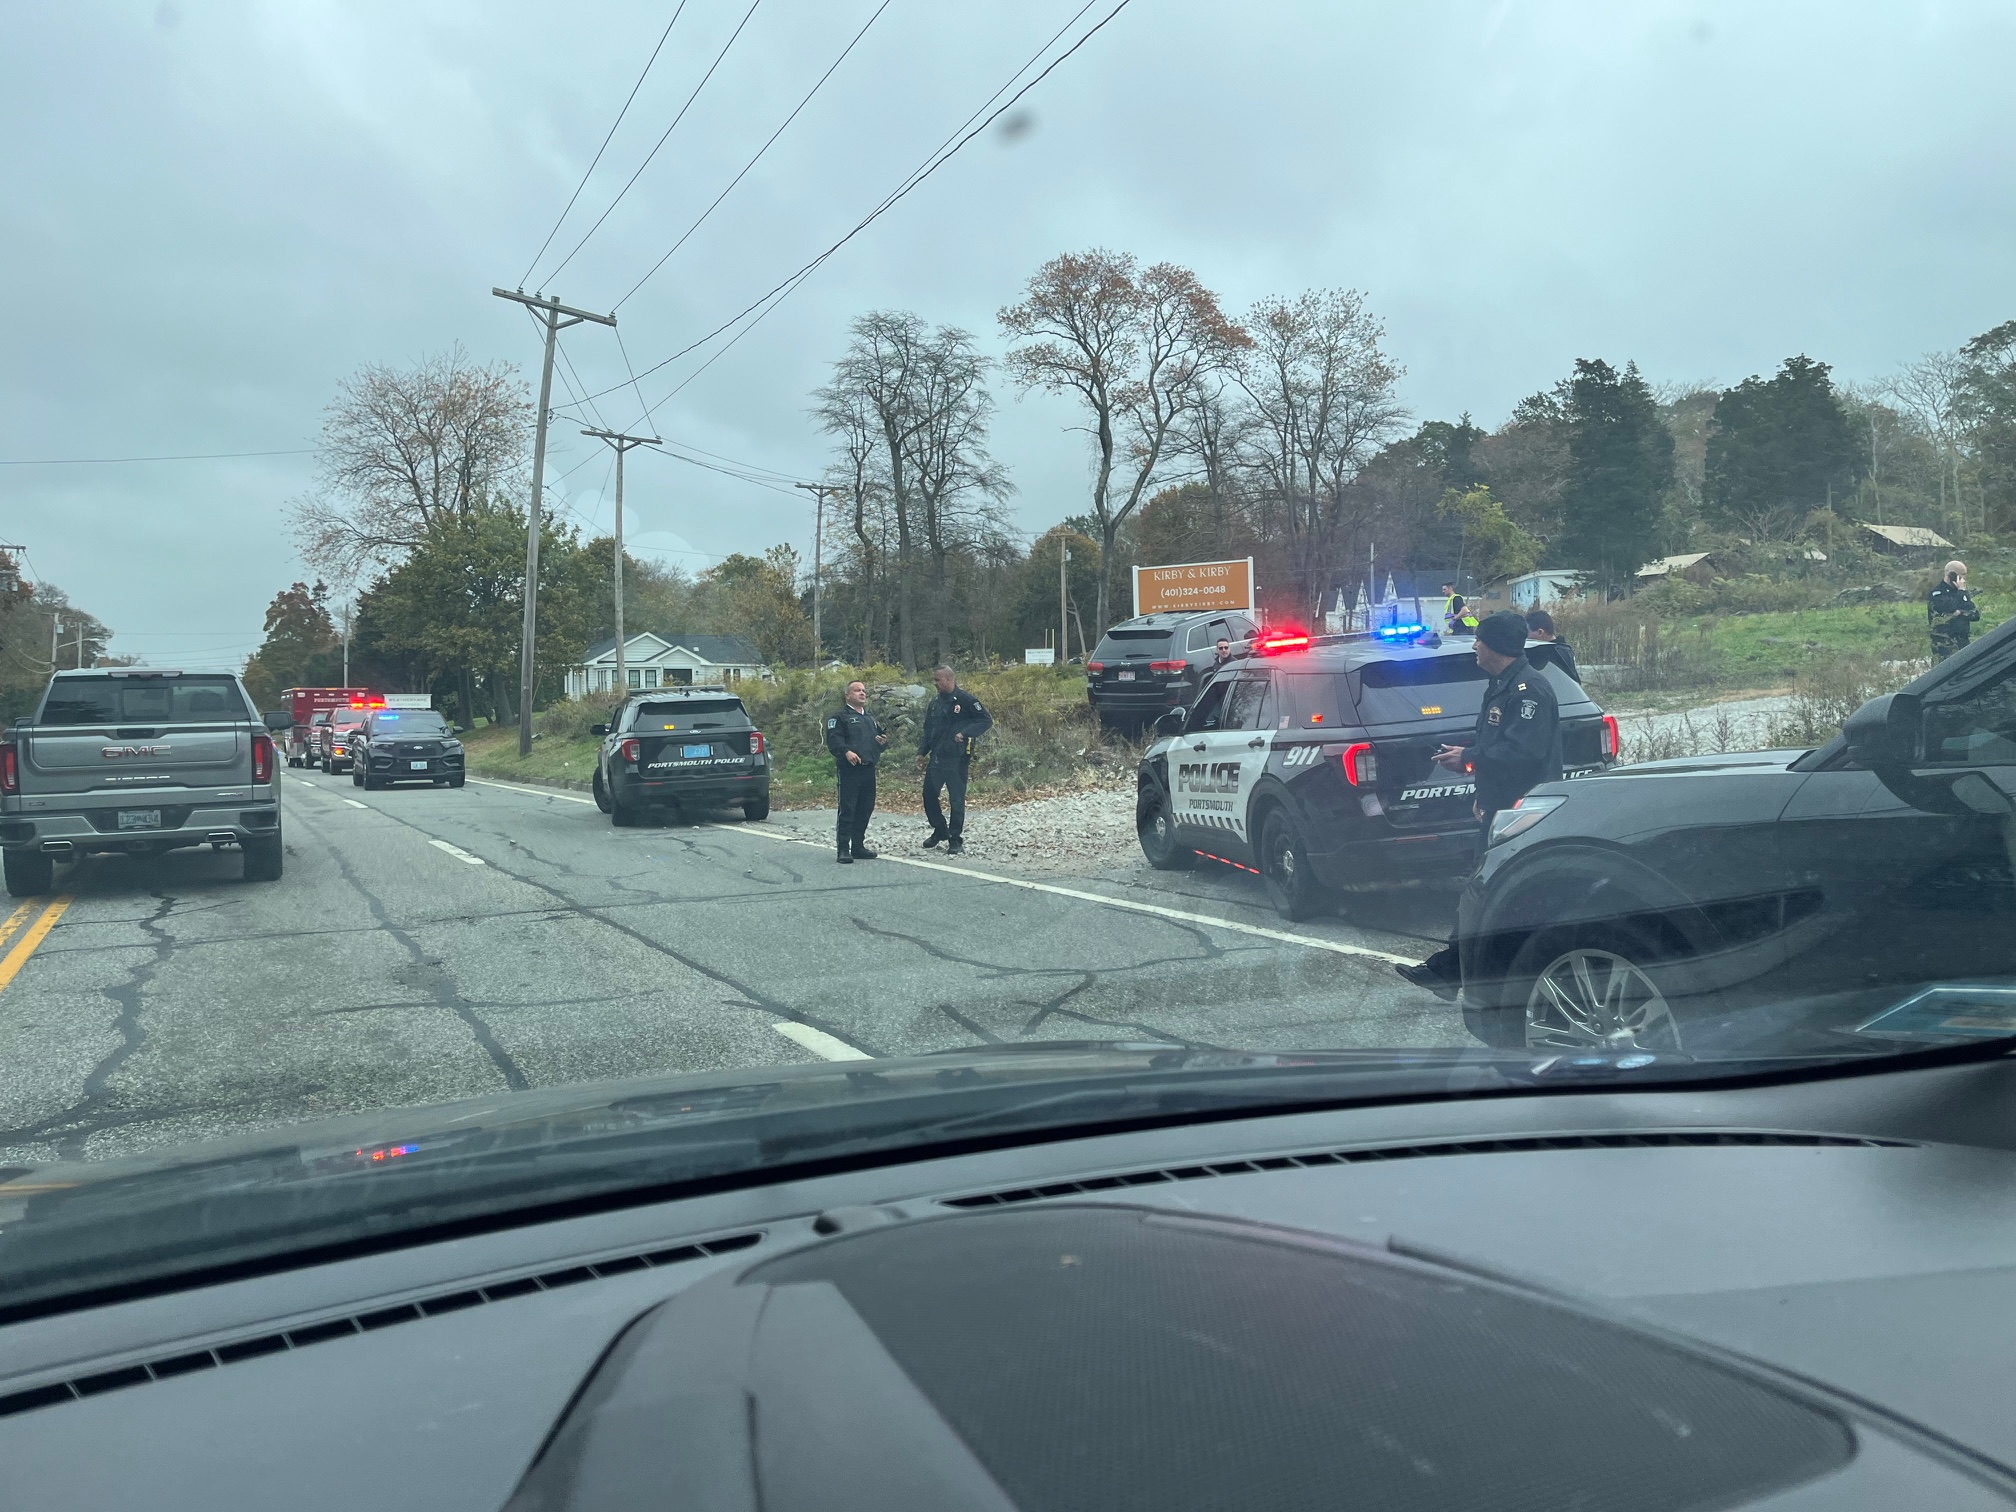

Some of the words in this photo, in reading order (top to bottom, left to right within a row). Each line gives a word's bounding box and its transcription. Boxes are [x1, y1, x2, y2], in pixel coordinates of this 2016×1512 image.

[1154, 569, 1185, 581] KIRBY
[1187, 568, 1196, 579] &
[1199, 566, 1231, 578] KIRBY
[1160, 585, 1226, 598] (401)324-0048
[1151, 600, 1235, 610] WWW.KIRBYKIRBY.COM
[101, 745, 171, 758] GMC
[1282, 745, 1321, 767] 911
[647, 759, 712, 769] PORTSMOUTH
[713, 757, 746, 765] POLICE
[1178, 762, 1242, 794] POLICE
[1188, 798, 1234, 812] PORTSMOUTH
